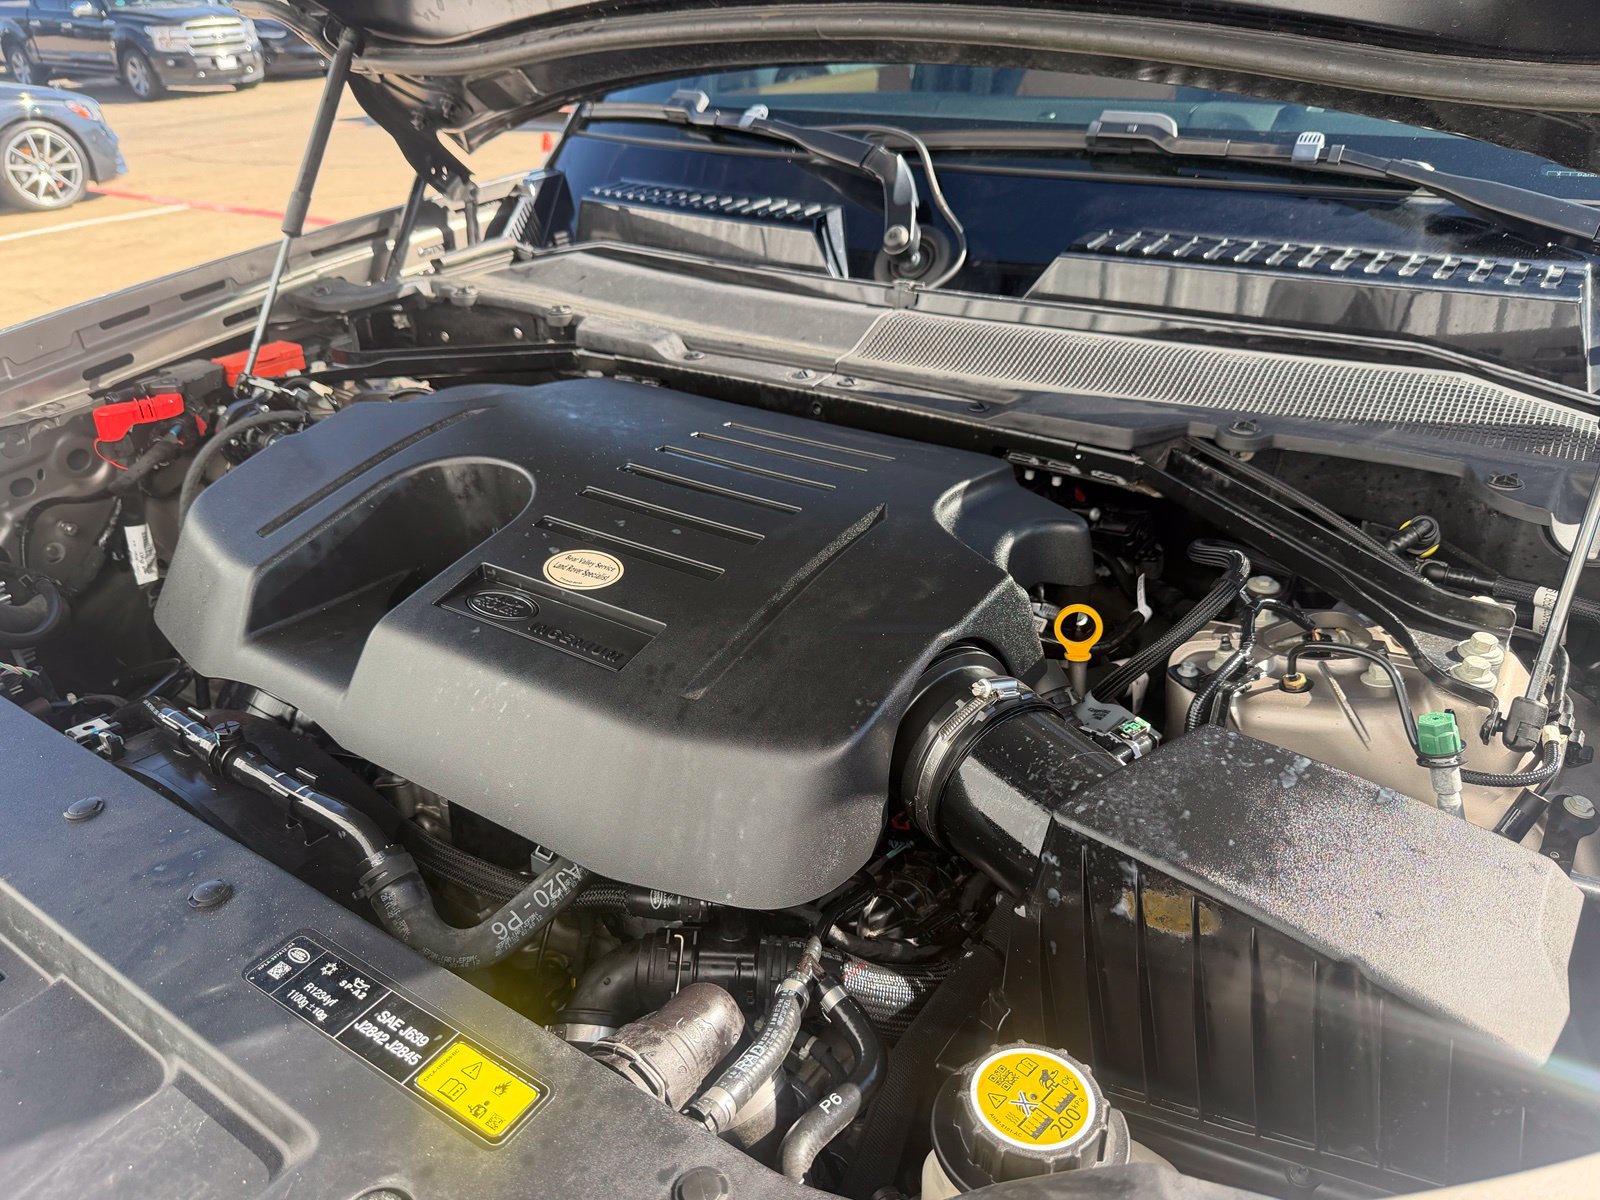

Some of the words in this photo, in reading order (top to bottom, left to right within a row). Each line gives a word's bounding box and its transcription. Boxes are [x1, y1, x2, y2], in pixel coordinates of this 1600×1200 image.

[553, 561, 567, 571] Land
[566, 564, 583, 575] Rover
[581, 569, 610, 581] Specialist
[579, 557, 595, 567] Valley
[594, 562, 616, 572] Service
[528, 622, 624, 663] INGENIUM
[532, 862, 581, 908] AJ20
[491, 910, 525, 941] P6
[303, 982, 339, 1007] R1234yf
[353, 1019, 390, 1046] J2842
[385, 1040, 422, 1066] J2845
[376, 1010, 405, 1031] SAE
[399, 1026, 430, 1047] J639
[1061, 1074, 1073, 1086] OK
[819, 1093, 843, 1114] P6
[1050, 1107, 1081, 1138] 200
